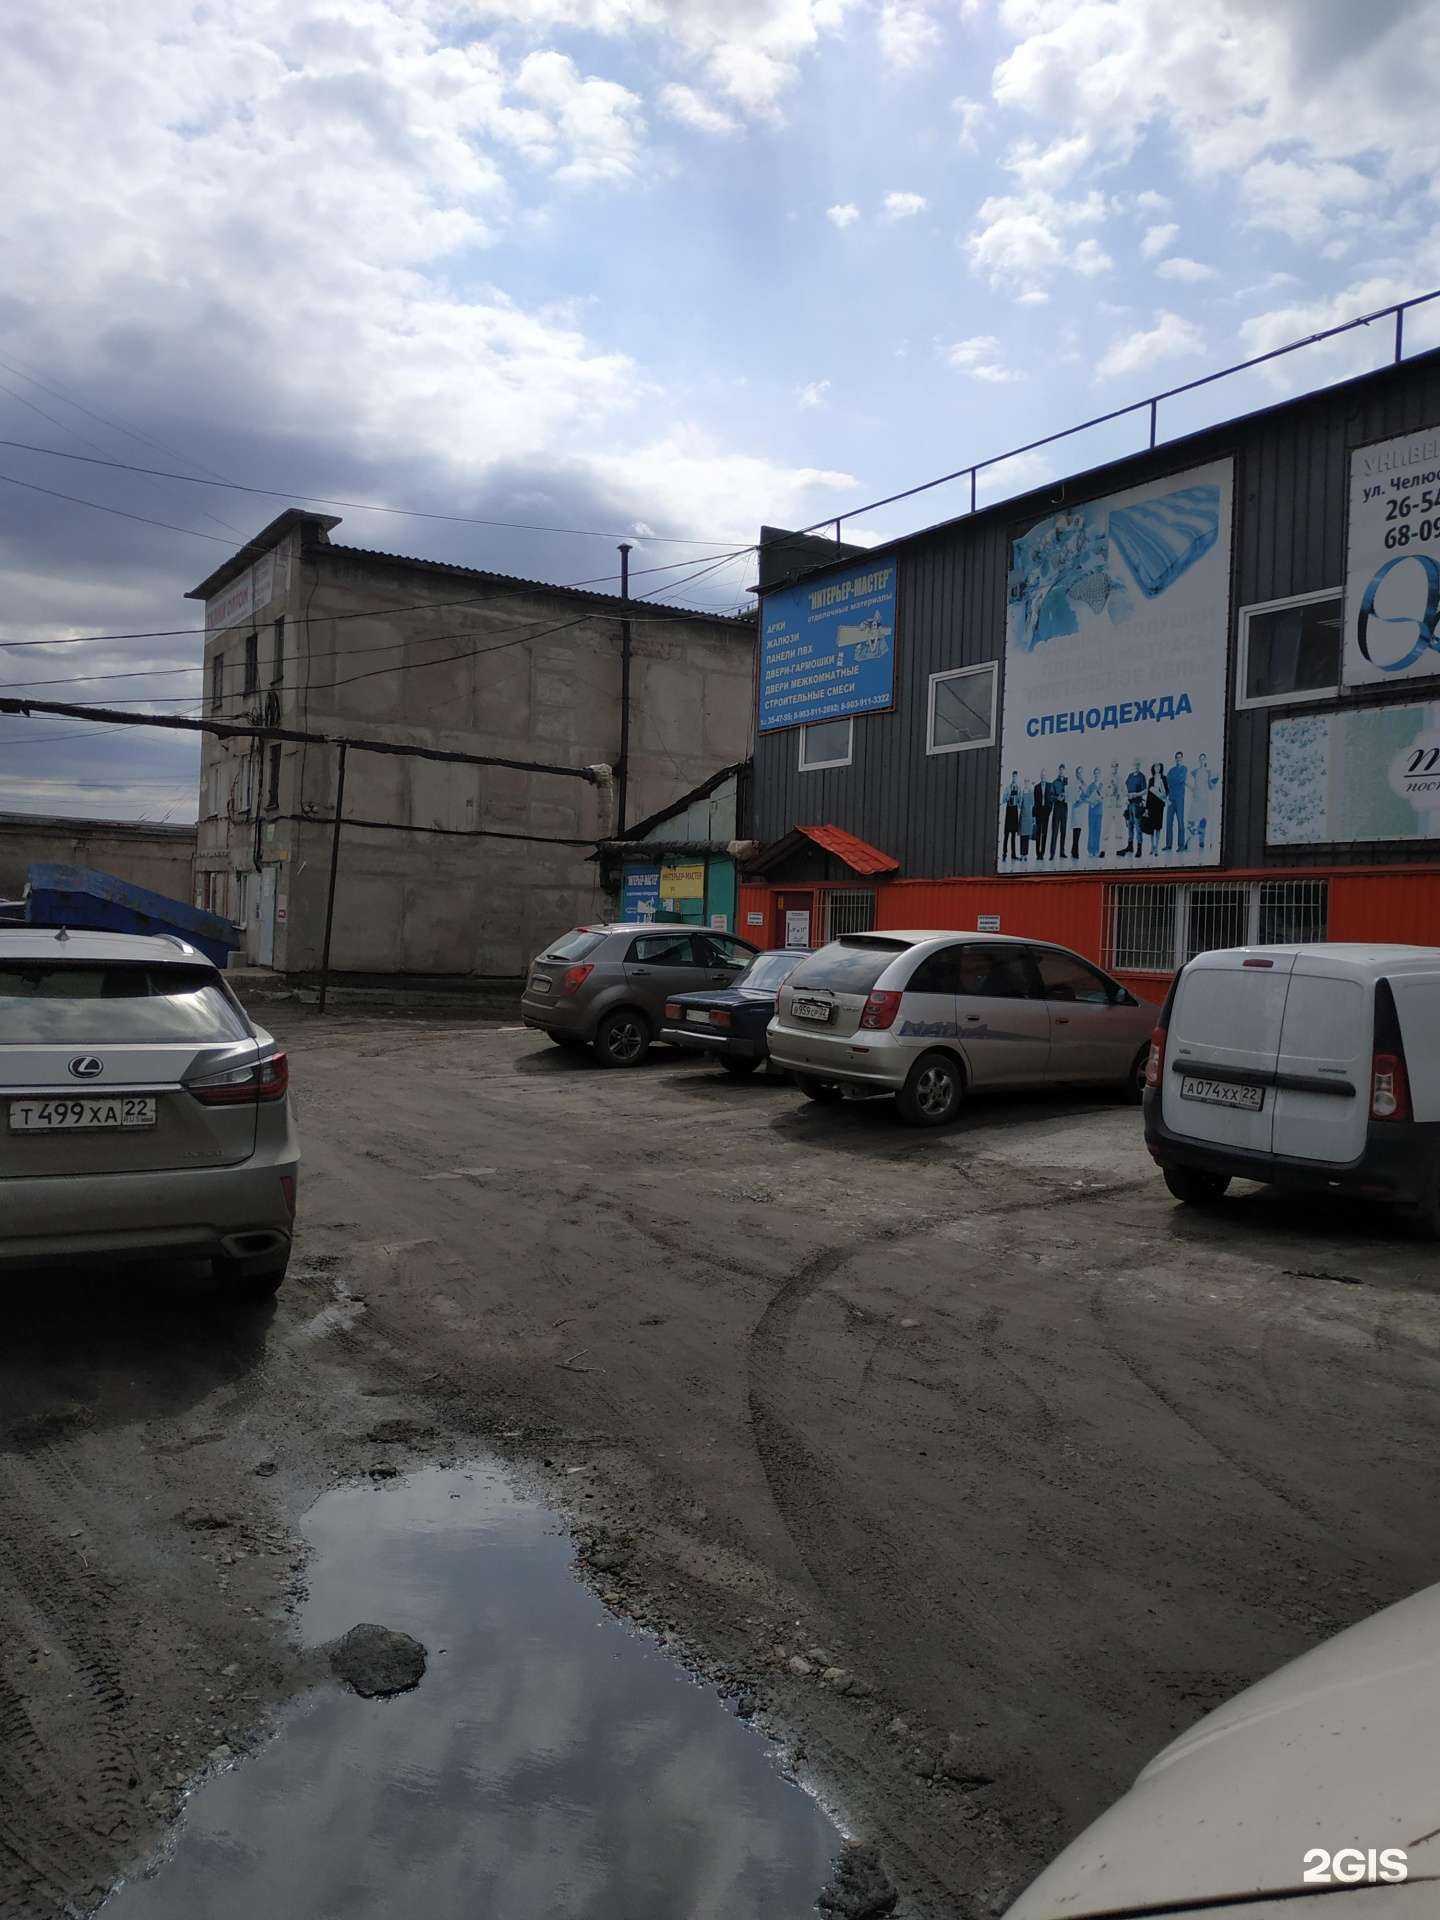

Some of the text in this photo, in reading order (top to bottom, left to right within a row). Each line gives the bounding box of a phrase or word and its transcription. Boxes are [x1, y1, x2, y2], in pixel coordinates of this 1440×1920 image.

[1364, 440, 1440, 477] УНИВЕ
[1363, 484, 1386, 503] ул.
[767, 621, 786, 634] АРКИ
[766, 632, 800, 649] ЖАЛЮЗИ
[766, 644, 813, 665] ПАНЕЛИ ПВХ
[765, 665, 860, 696] ДВЕРИ МЕЖКОМНАТНЫЕ
[764, 683, 855, 709] СТРОИТЕЛЬНЫЕ СМЕСИ
[1026, 692, 1192, 738] СПЕЦОДЕЖДА
[1187, 1081, 1257, 1101] А074ХХ 22
[20, 1100, 148, 1125] Т499ХА 22
